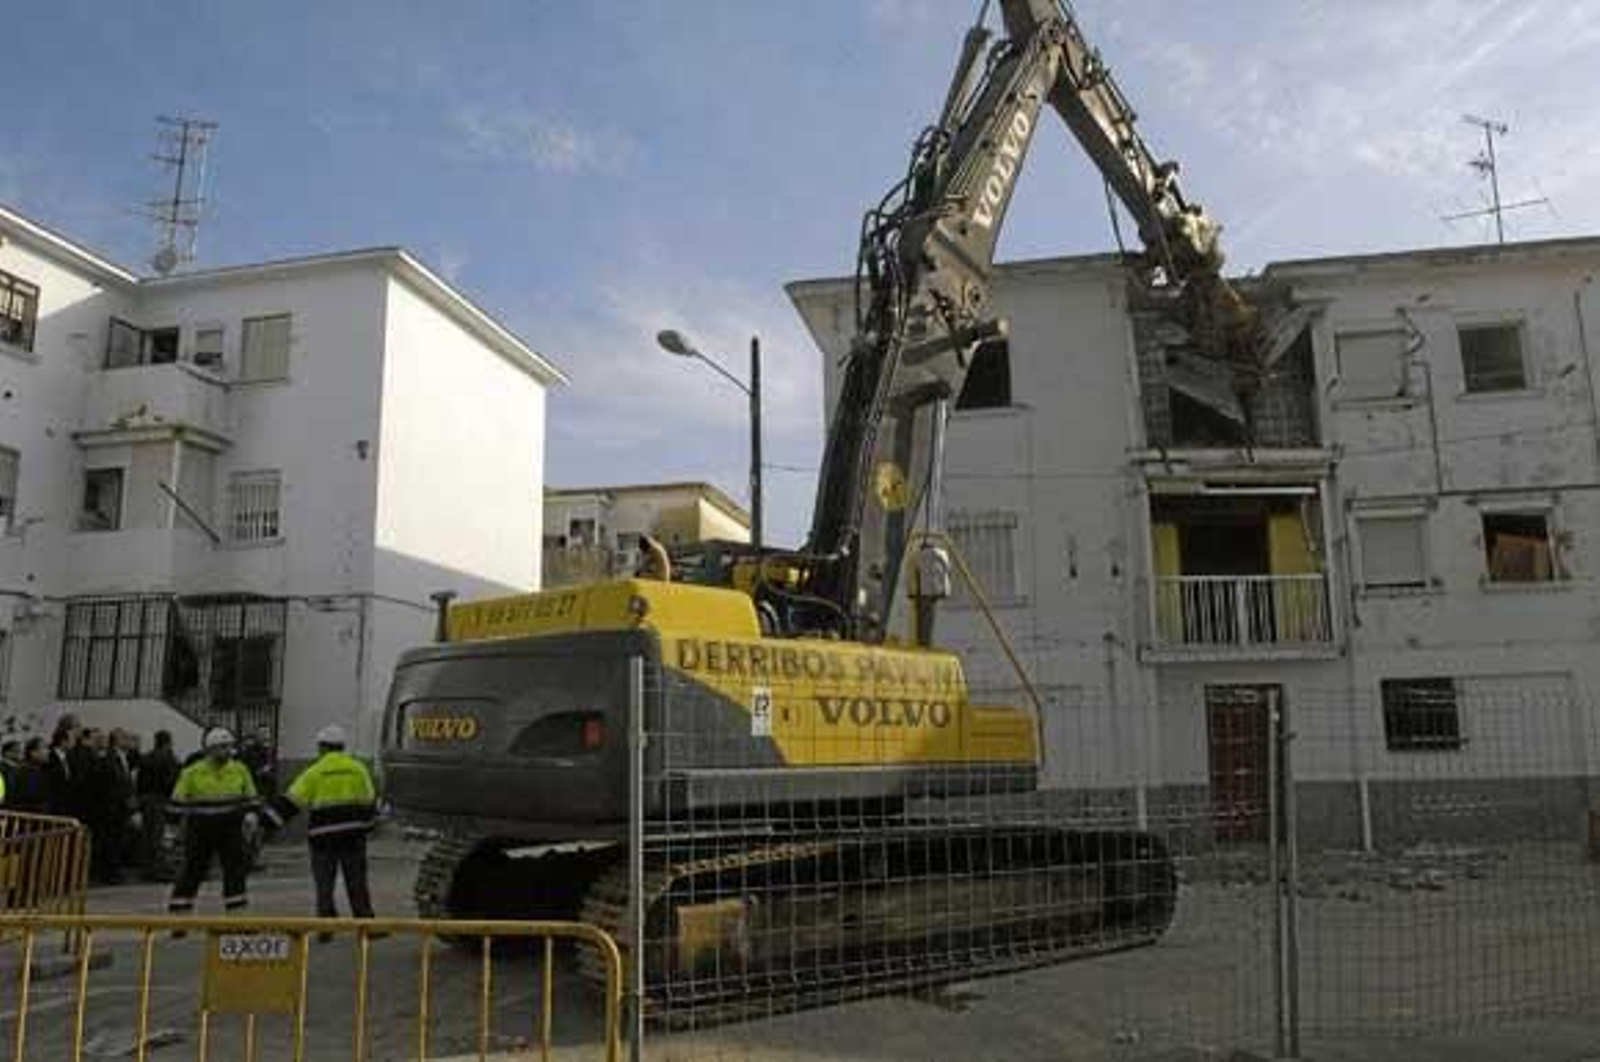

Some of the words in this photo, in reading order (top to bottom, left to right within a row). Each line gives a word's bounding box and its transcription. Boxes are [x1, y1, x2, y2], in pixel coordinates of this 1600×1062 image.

[972, 111, 1030, 230] VOLVO
[676, 637, 845, 680] DERRIBOS
[409, 716, 476, 740] VOLVO
[816, 697, 951, 728] VOLVO
[222, 938, 288, 956] axor
